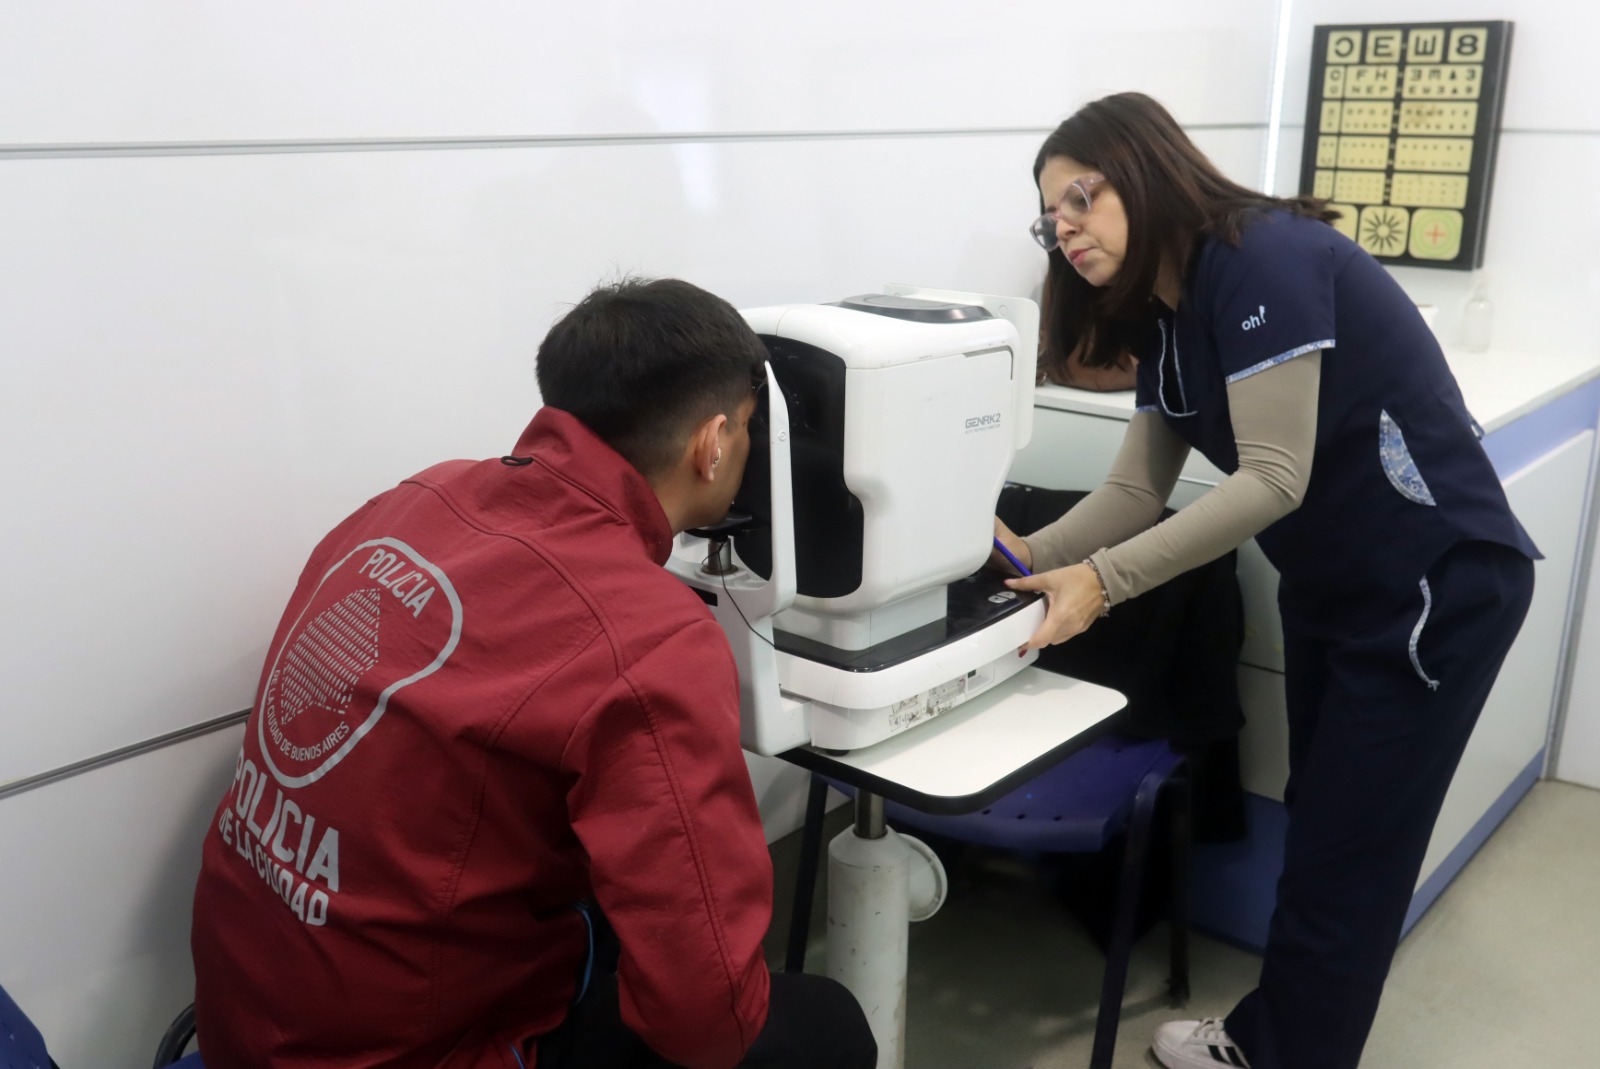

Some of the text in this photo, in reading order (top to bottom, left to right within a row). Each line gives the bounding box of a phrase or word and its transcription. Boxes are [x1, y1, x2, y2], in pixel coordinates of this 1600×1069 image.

[1240, 305, 1266, 331] oh!
[358, 548, 436, 619] POLICIA
[267, 687, 276, 706] LA
[267, 705, 283, 745] CIUDAD
[322, 721, 350, 754] AIRES
[279, 738, 292, 756] DE
[290, 743, 322, 762] BUENOS
[234, 819, 255, 869] LA
[254, 844, 330, 927] CIUDAD
